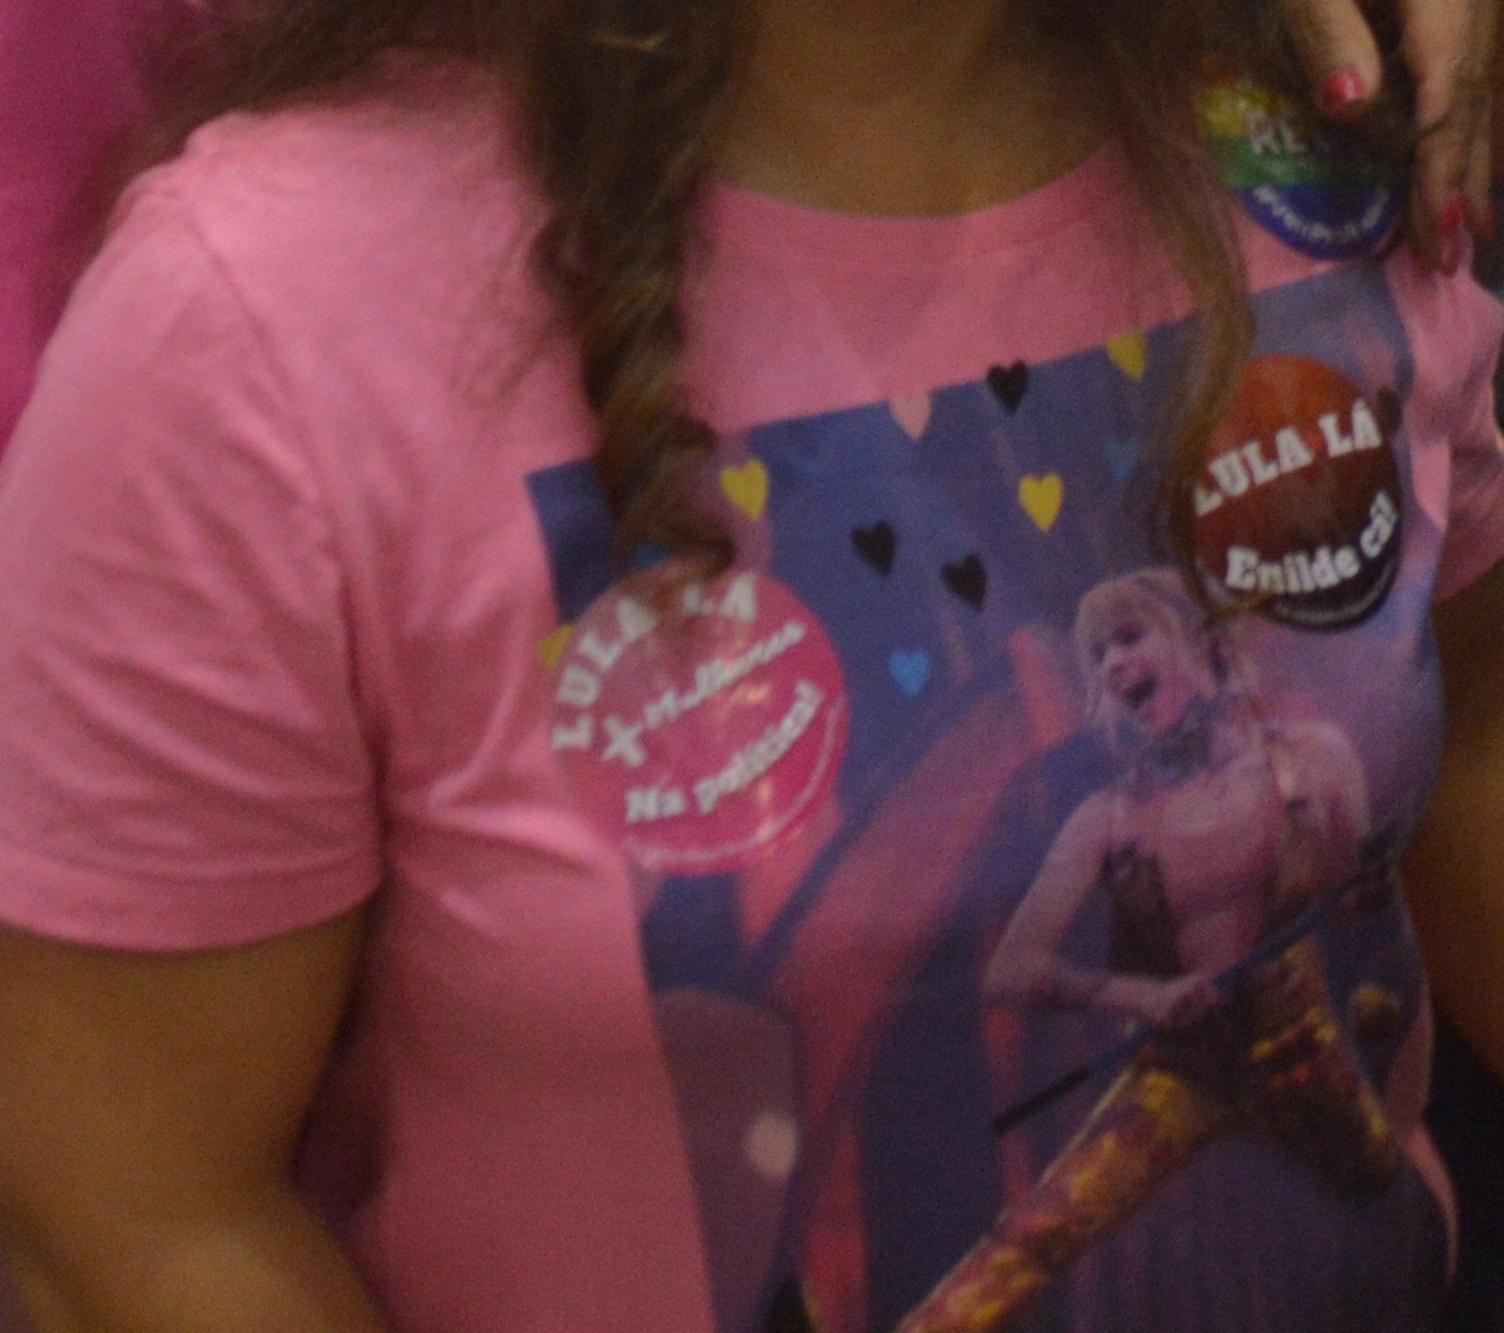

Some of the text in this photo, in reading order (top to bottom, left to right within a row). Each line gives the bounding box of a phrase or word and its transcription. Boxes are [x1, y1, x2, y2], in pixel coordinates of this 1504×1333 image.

[1194, 425, 1316, 519] LULA
[1225, 545, 1362, 595] Enilde
[551, 597, 659, 752] LULA
[626, 785, 687, 826] Na
